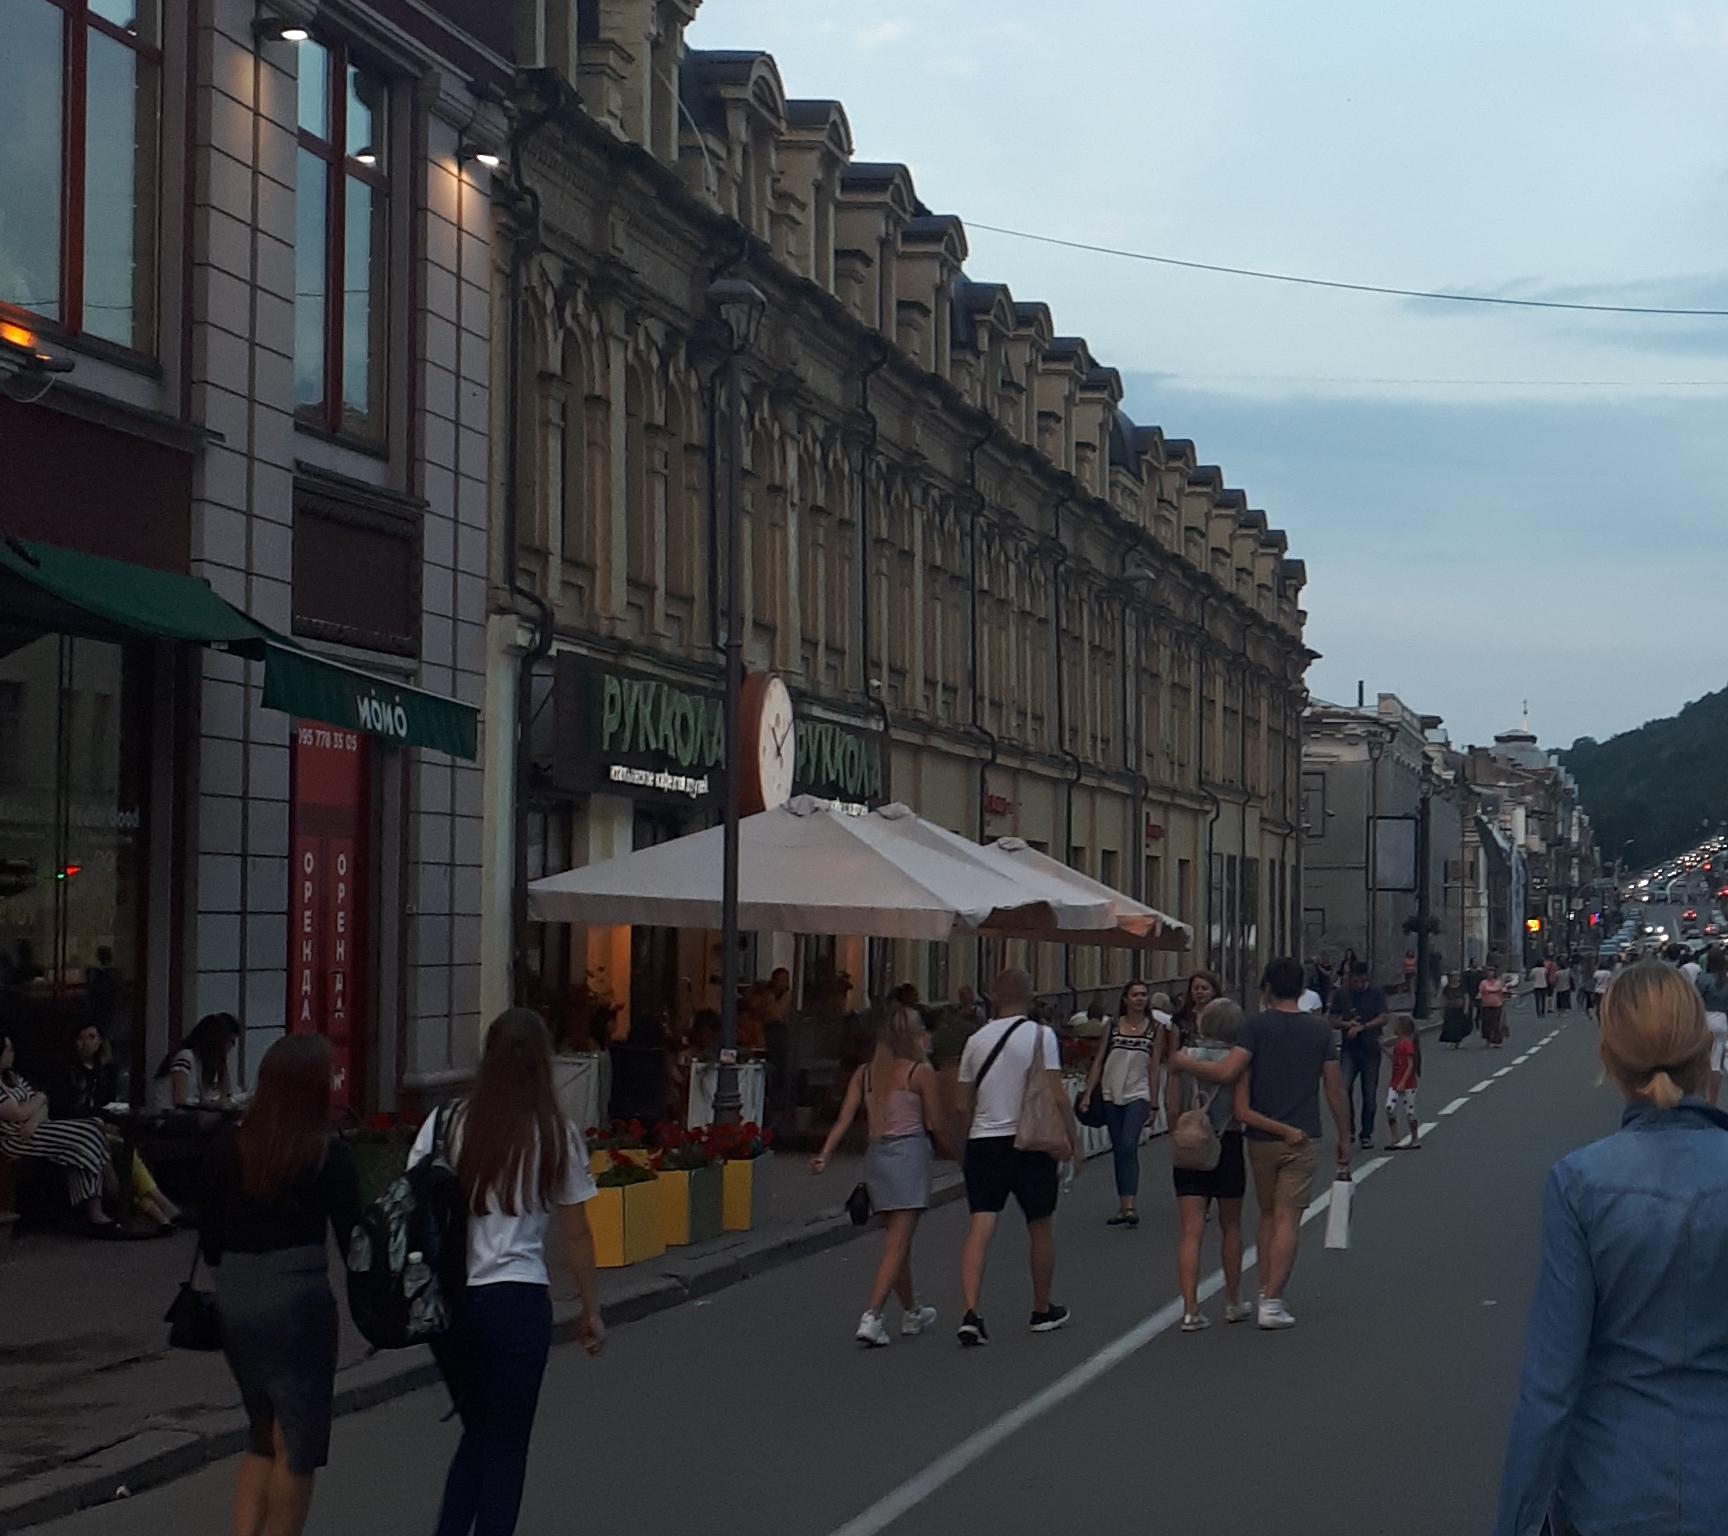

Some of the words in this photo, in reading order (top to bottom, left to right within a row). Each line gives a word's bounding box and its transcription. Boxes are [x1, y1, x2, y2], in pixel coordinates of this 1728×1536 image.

[602, 674, 726, 770] РУККОЛА
[301, 851, 314, 1021] ОРЕНДА
[334, 853, 347, 1018] ОРЕНДА
